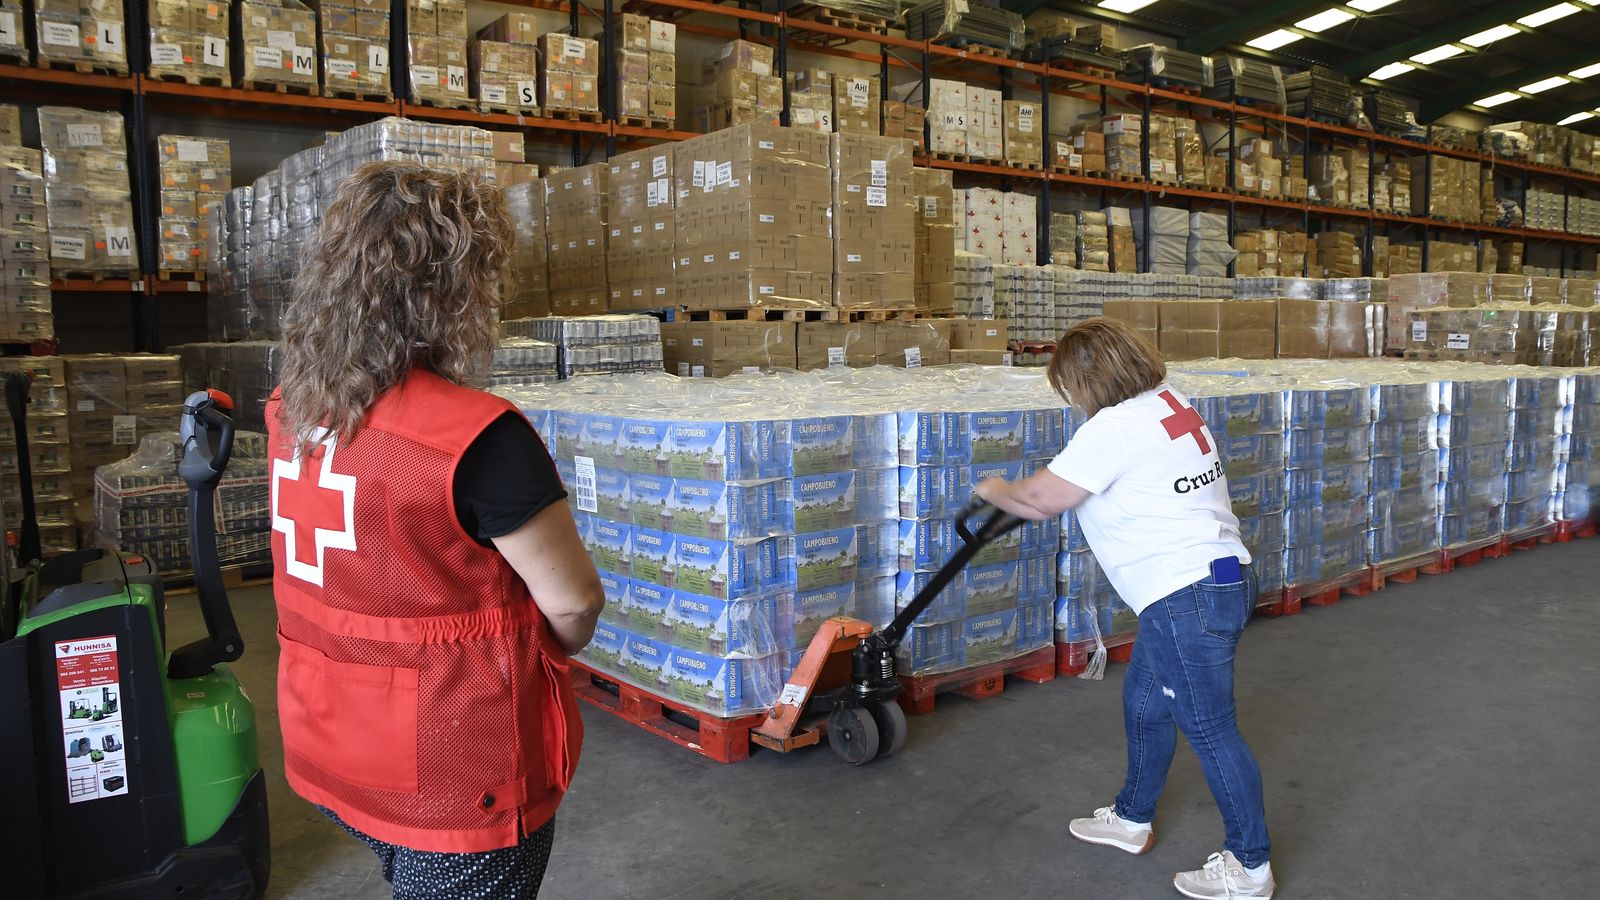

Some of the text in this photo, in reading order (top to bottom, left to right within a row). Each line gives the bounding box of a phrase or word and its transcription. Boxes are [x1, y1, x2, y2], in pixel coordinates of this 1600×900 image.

[104, 29, 114, 44] L
[210, 43, 219, 57] L
[296, 55, 312, 70] M
[375, 54, 383, 67] L
[450, 74, 464, 87] M
[522, 87, 533, 103] S
[822, 115, 829, 126] S
[946, 115, 954, 124] M
[958, 116, 964, 126] S
[111, 236, 129, 250] M
[977, 416, 1008, 425] CAMPOBUENO
[675, 428, 706, 438] CAMPOBUENO
[799, 423, 834, 434] CAMPOBUENO
[800, 480, 836, 492] CAMPOBUENO
[1173, 468, 1216, 494] Cruz
[680, 486, 709, 497] CAMPOBUENO
[681, 542, 710, 555] CAMPOBUENO
[803, 535, 840, 549] CAMPOBUENO
[763, 541, 772, 578] CAMPOBUENO
[973, 569, 1003, 581] CAMPOBUENO
[801, 591, 837, 605] CAMPOBUENO
[679, 599, 709, 613] CAMPOBUENO
[971, 617, 1002, 631] CAMPOBUENO
[74, 642, 112, 652] HUNNISA
[676, 655, 707, 671] CAMPOBUENO
